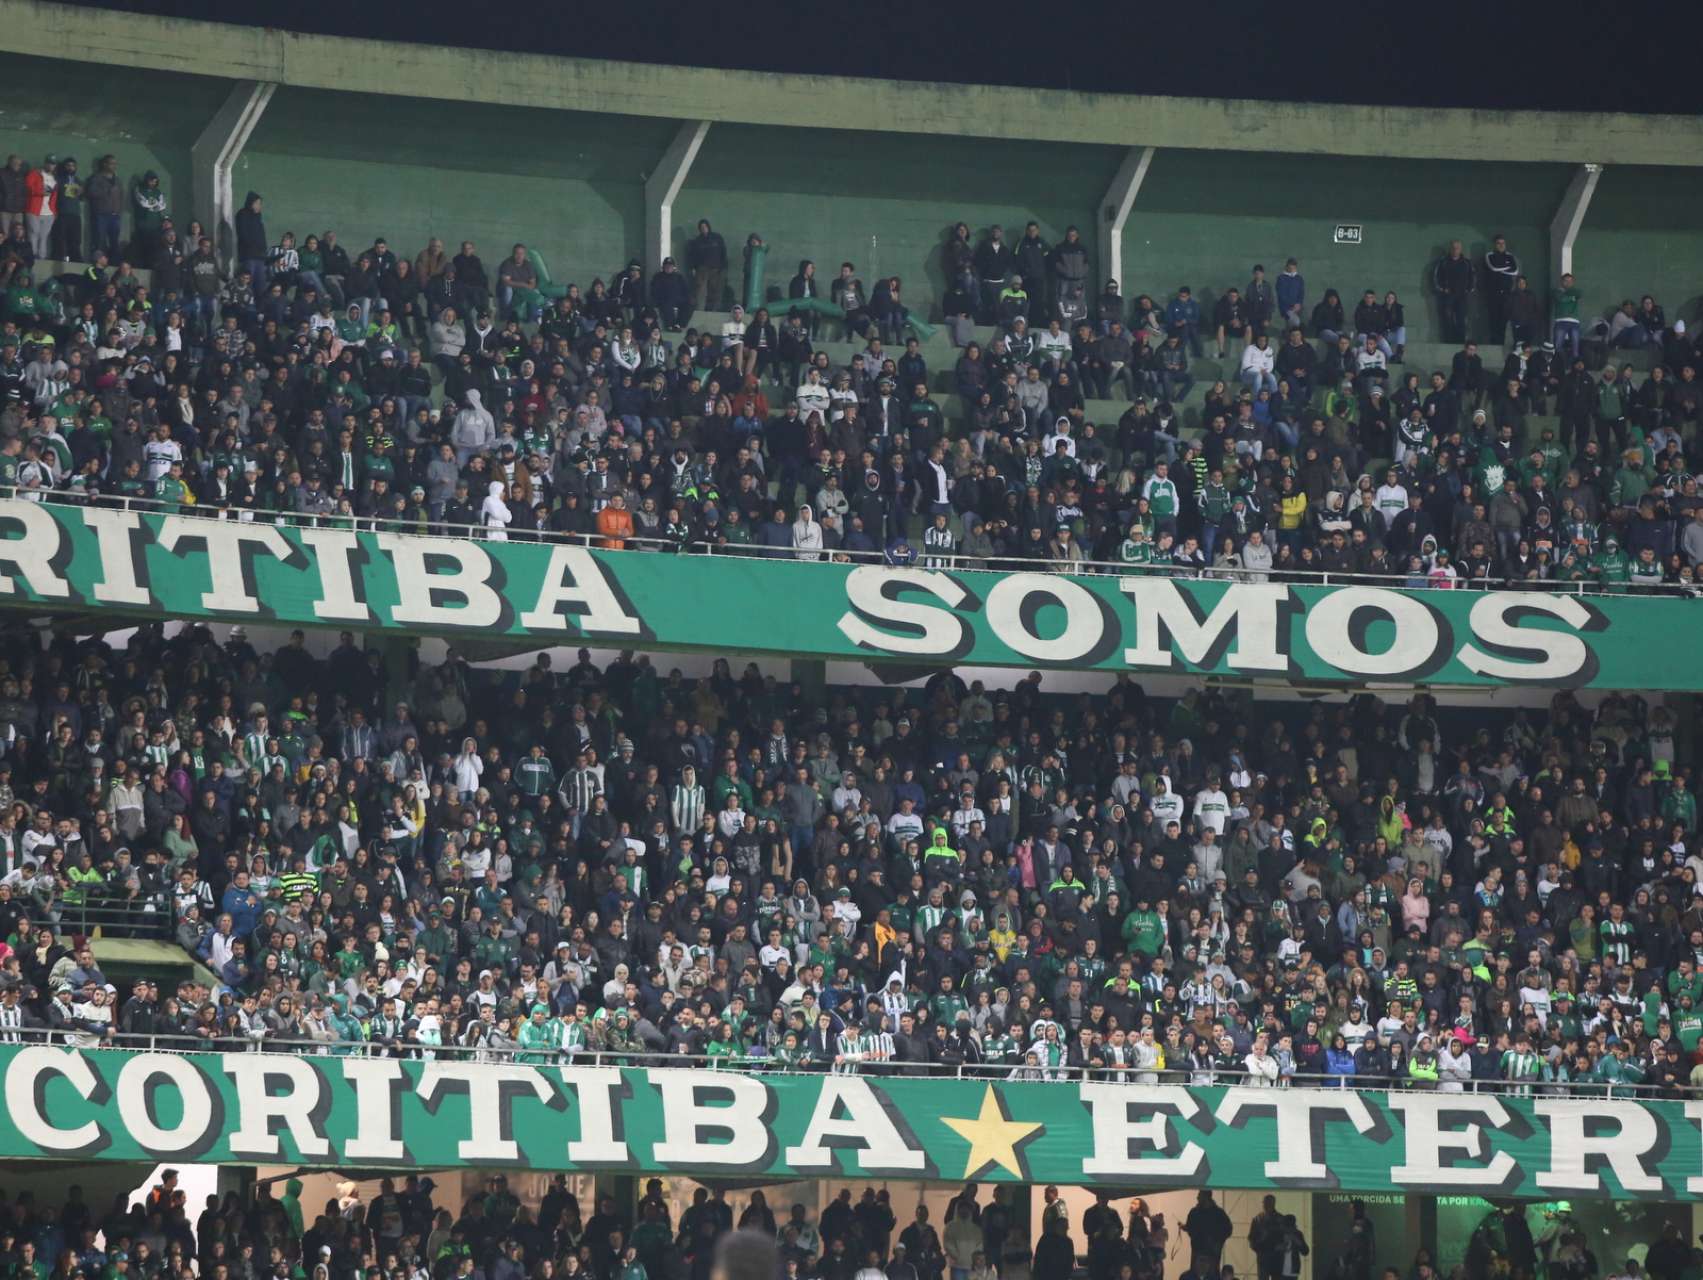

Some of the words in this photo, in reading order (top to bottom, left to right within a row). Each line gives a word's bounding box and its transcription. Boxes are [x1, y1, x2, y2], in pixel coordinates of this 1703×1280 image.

[0, 500, 640, 633] RITIBA
[837, 567, 1591, 680] SOMOS
[5, 1046, 926, 1170] CORITIBA
[1449, 1196, 1468, 1206] POR
